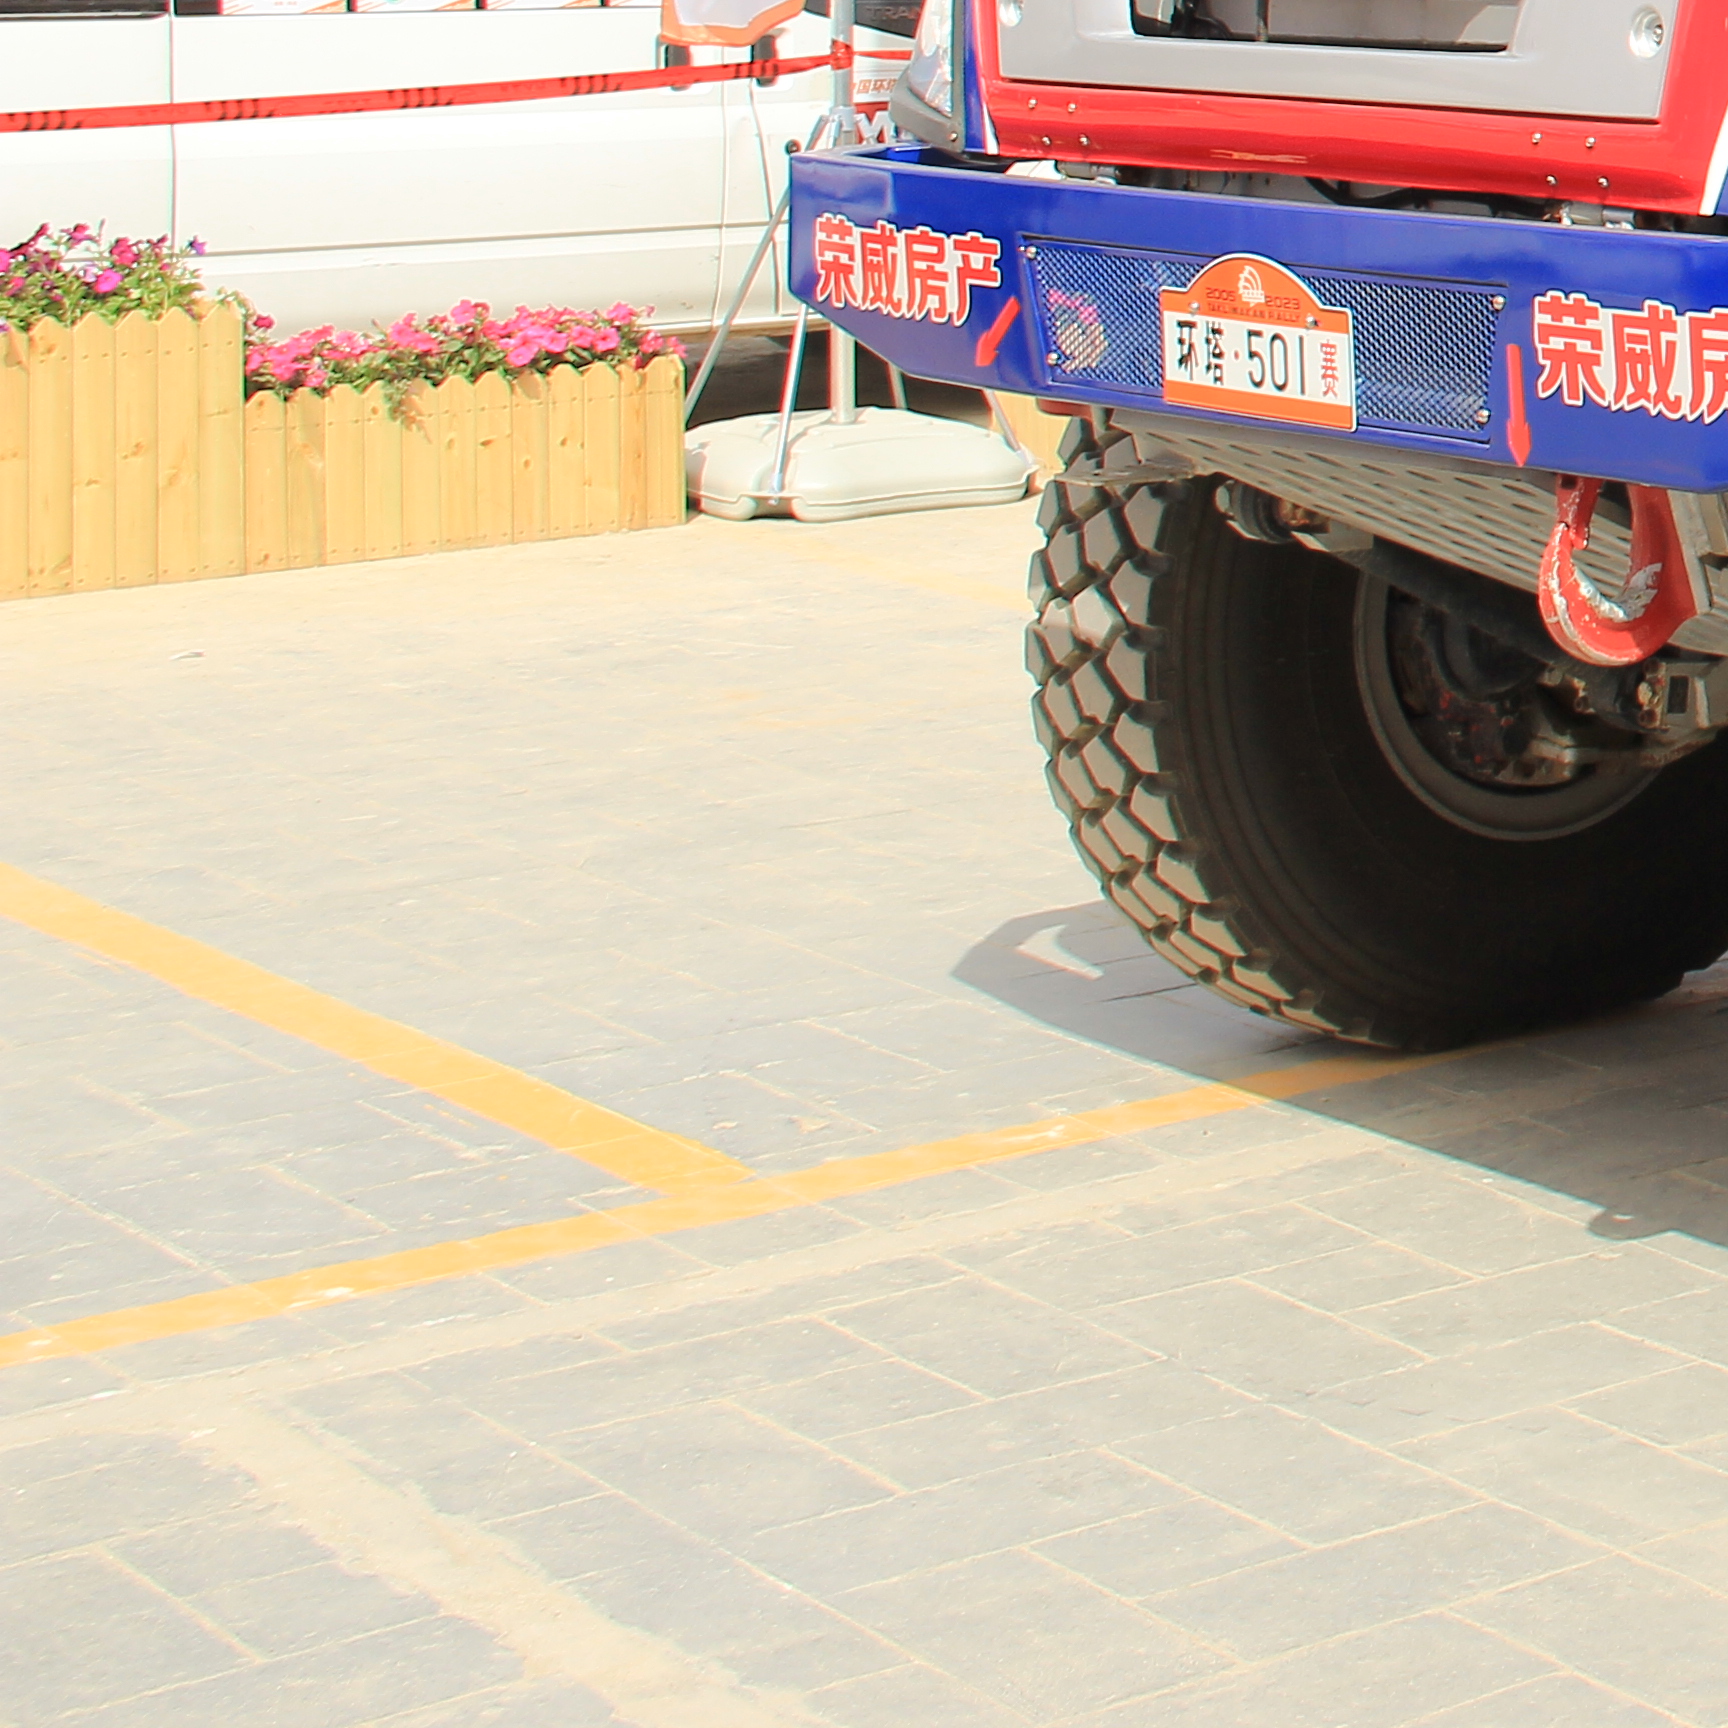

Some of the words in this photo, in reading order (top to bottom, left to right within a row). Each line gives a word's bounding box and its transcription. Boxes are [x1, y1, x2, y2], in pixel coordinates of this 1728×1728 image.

[814, 212, 1001, 326] 荣威房产
[1319, 339, 1340, 398] 赛
